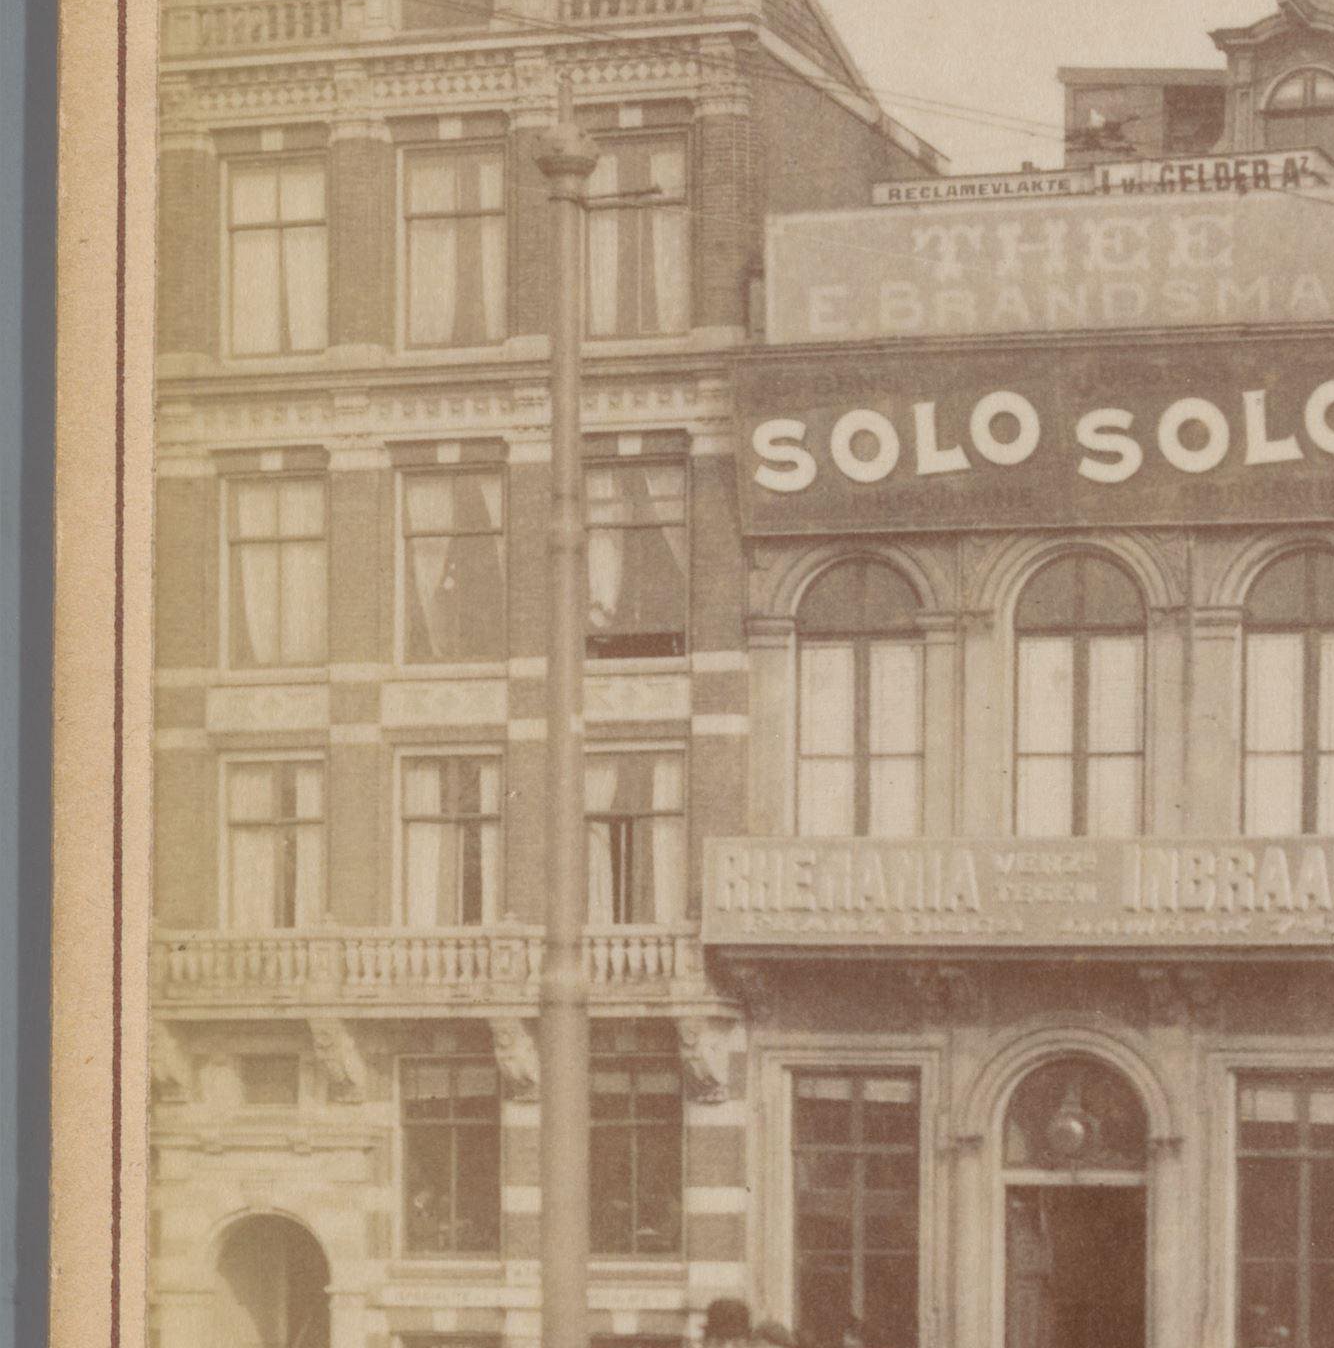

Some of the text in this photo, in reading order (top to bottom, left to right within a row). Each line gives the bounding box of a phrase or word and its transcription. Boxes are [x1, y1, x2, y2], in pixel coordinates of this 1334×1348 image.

[887, 176, 1071, 202] RECLAMEVLAKTE
[1160, 158, 1272, 194] GELDER
[910, 212, 1234, 283] THEE
[751, 389, 1042, 493] SOLO
